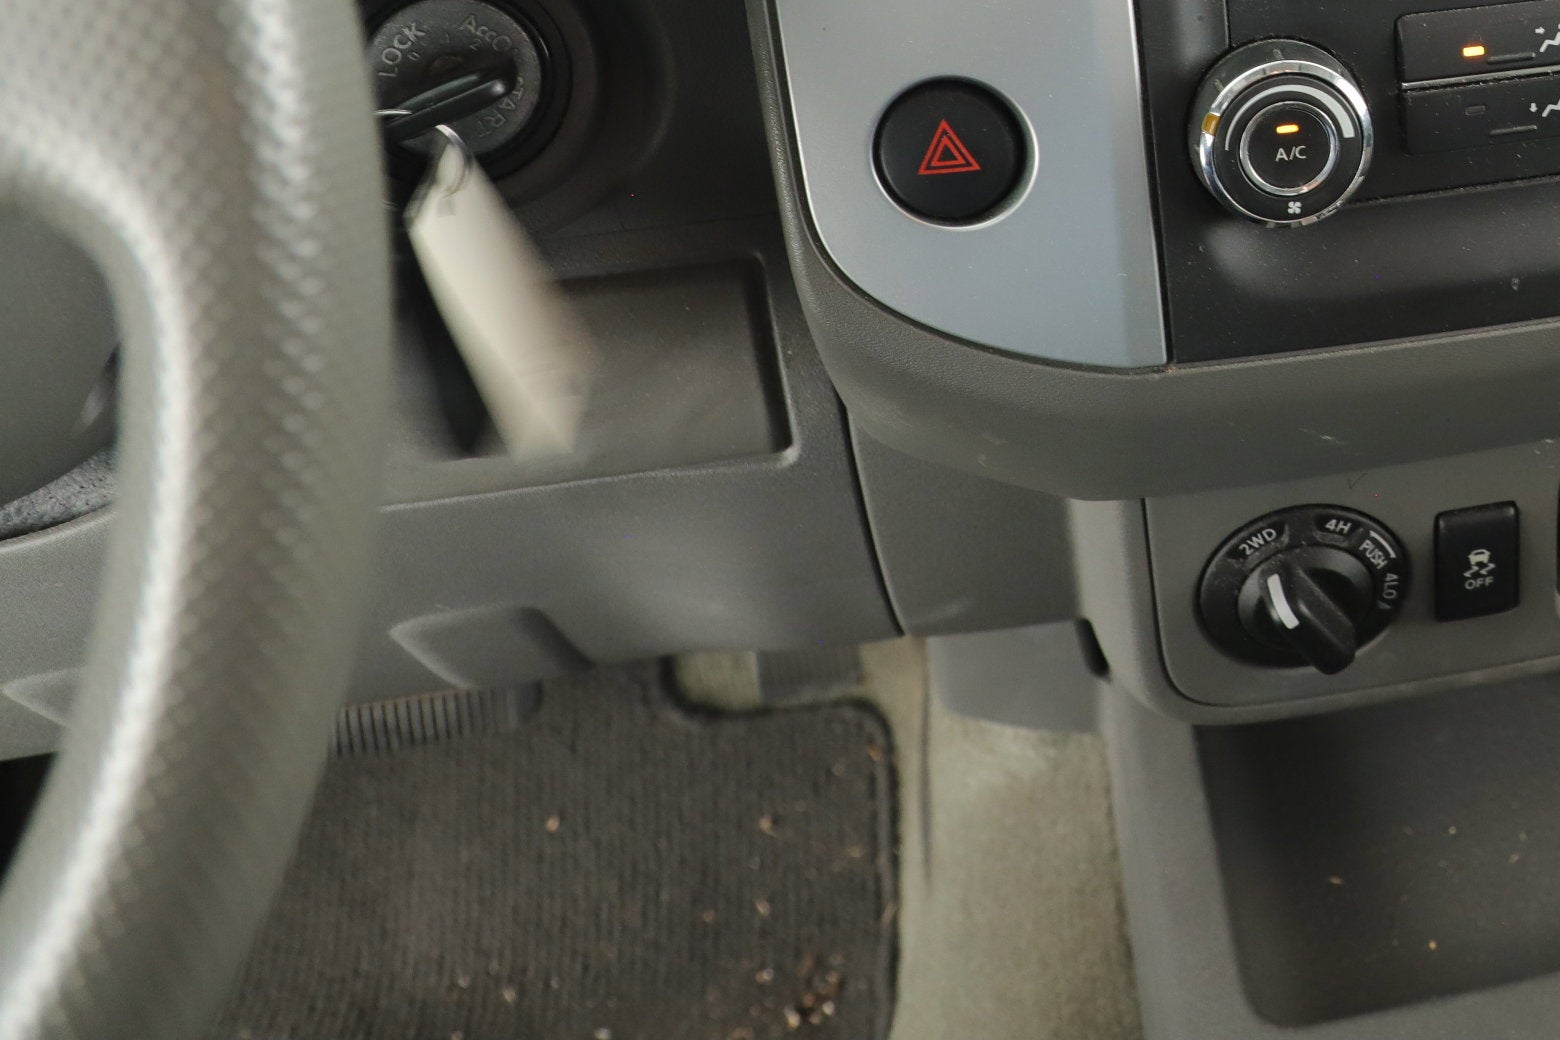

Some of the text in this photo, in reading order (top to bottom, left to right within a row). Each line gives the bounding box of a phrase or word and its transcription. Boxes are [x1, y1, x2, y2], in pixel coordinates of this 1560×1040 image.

[378, 22, 426, 78] LOCK
[1275, 145, 1307, 162] A/C
[1324, 518, 1352, 535] 4H
[1238, 527, 1277, 556] 2WD
[1358, 539, 1388, 570] PUSH
[1382, 572, 1399, 599] 4LO
[1464, 575, 1494, 591] OFF
